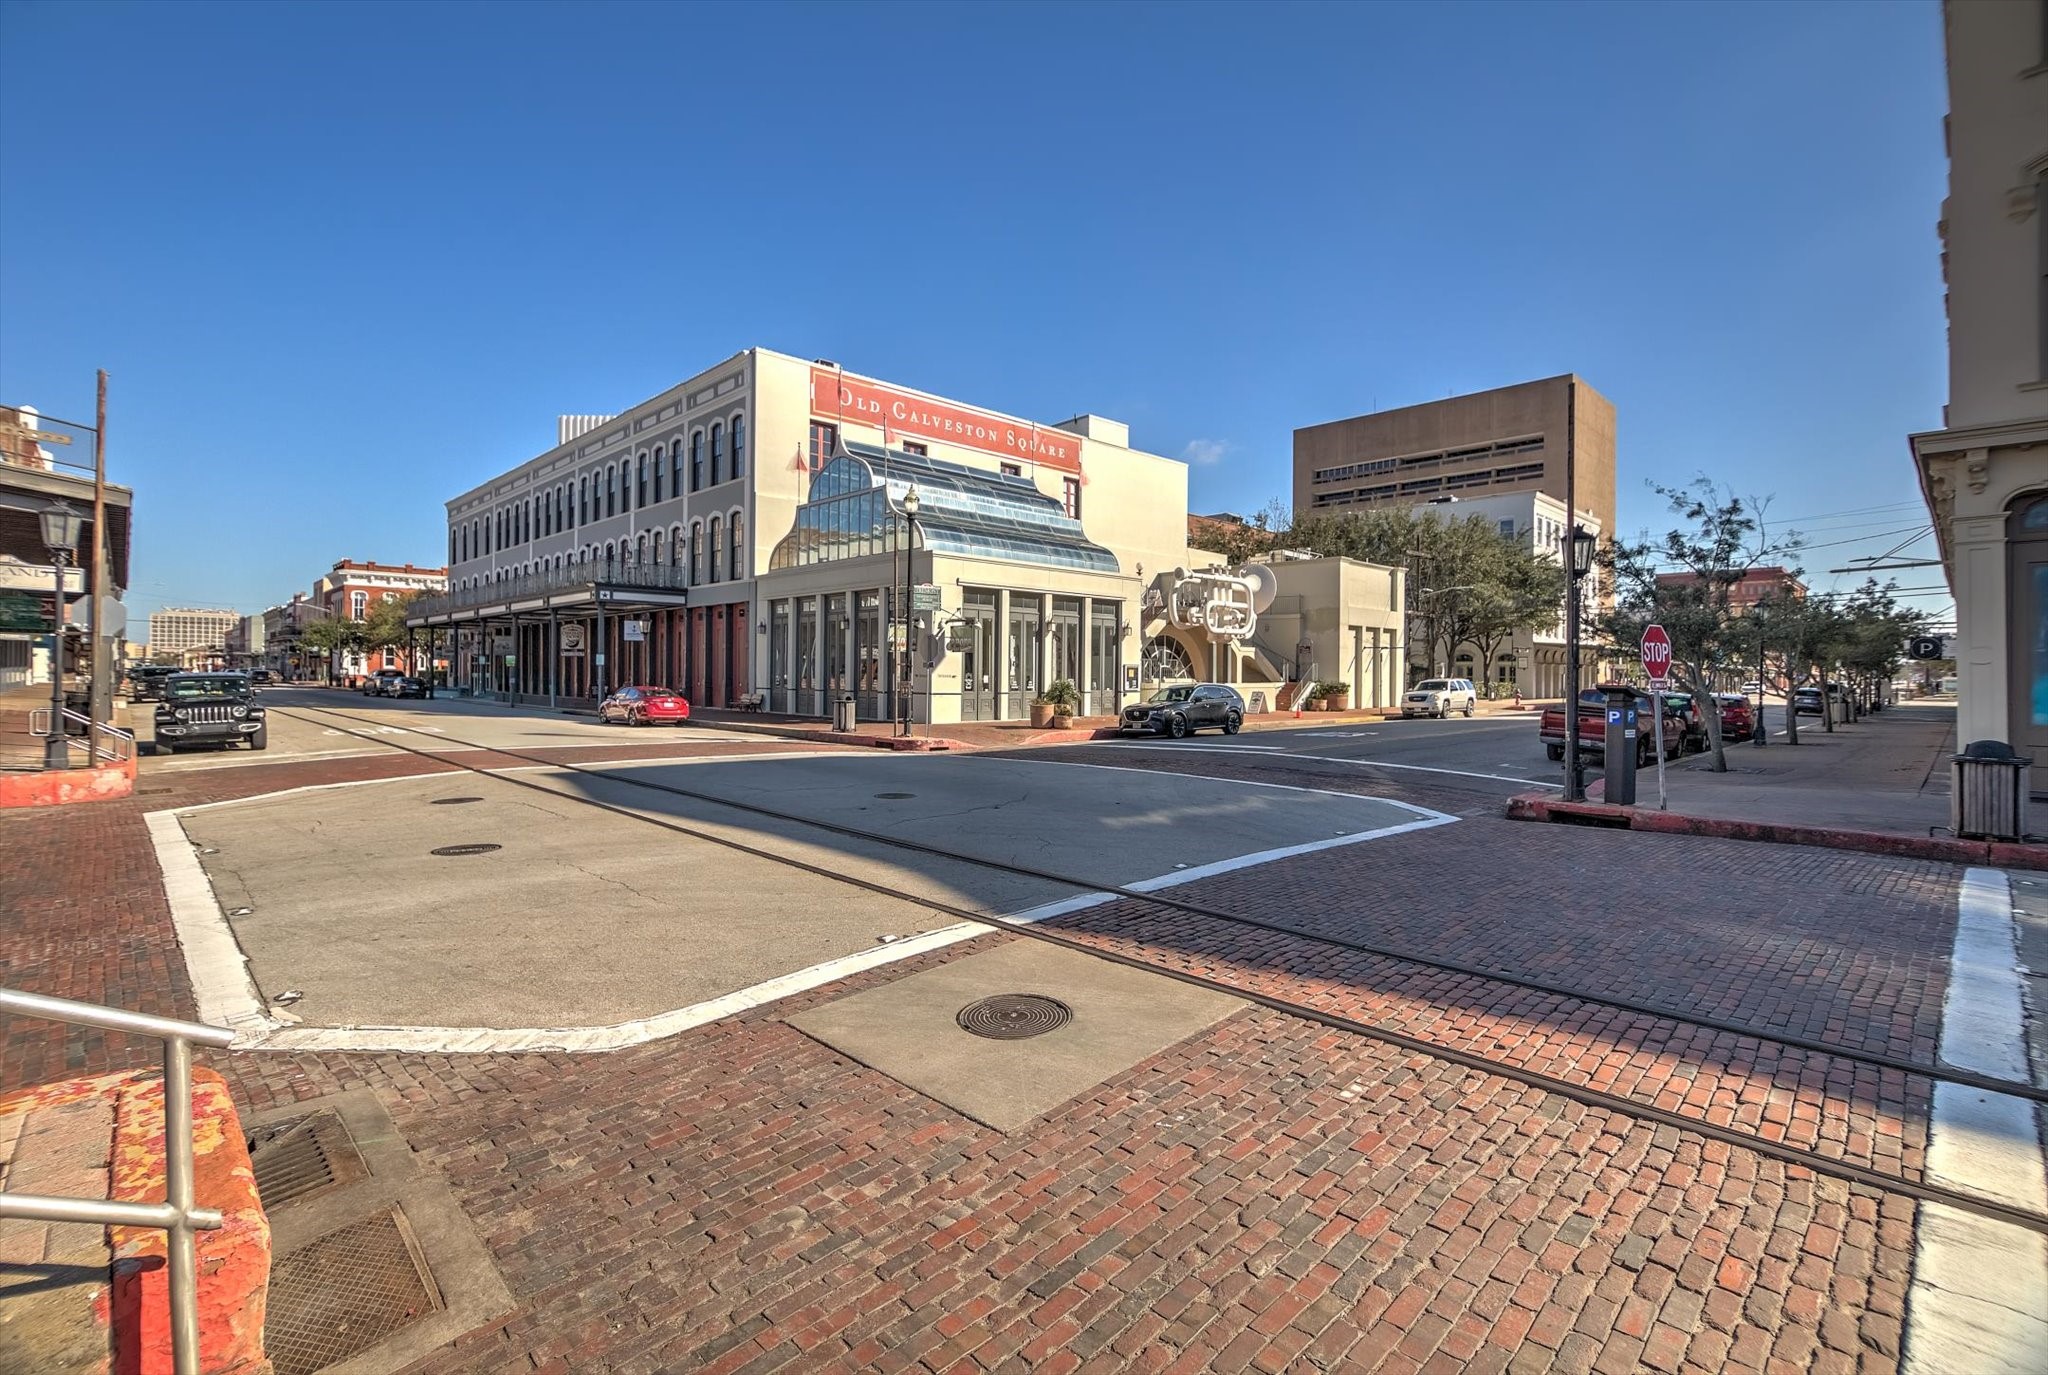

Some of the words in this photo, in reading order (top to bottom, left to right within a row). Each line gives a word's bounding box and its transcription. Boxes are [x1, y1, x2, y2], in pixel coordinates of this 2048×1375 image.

[839, 387, 881, 414] OLD
[892, 401, 998, 442] GALVESTON
[1006, 430, 1066, 459] SQUARE
[1643, 642, 1669, 663] STOP
[1920, 642, 1933, 654] P
[1608, 711, 1620, 723] P
[1627, 710, 1635, 721] P
